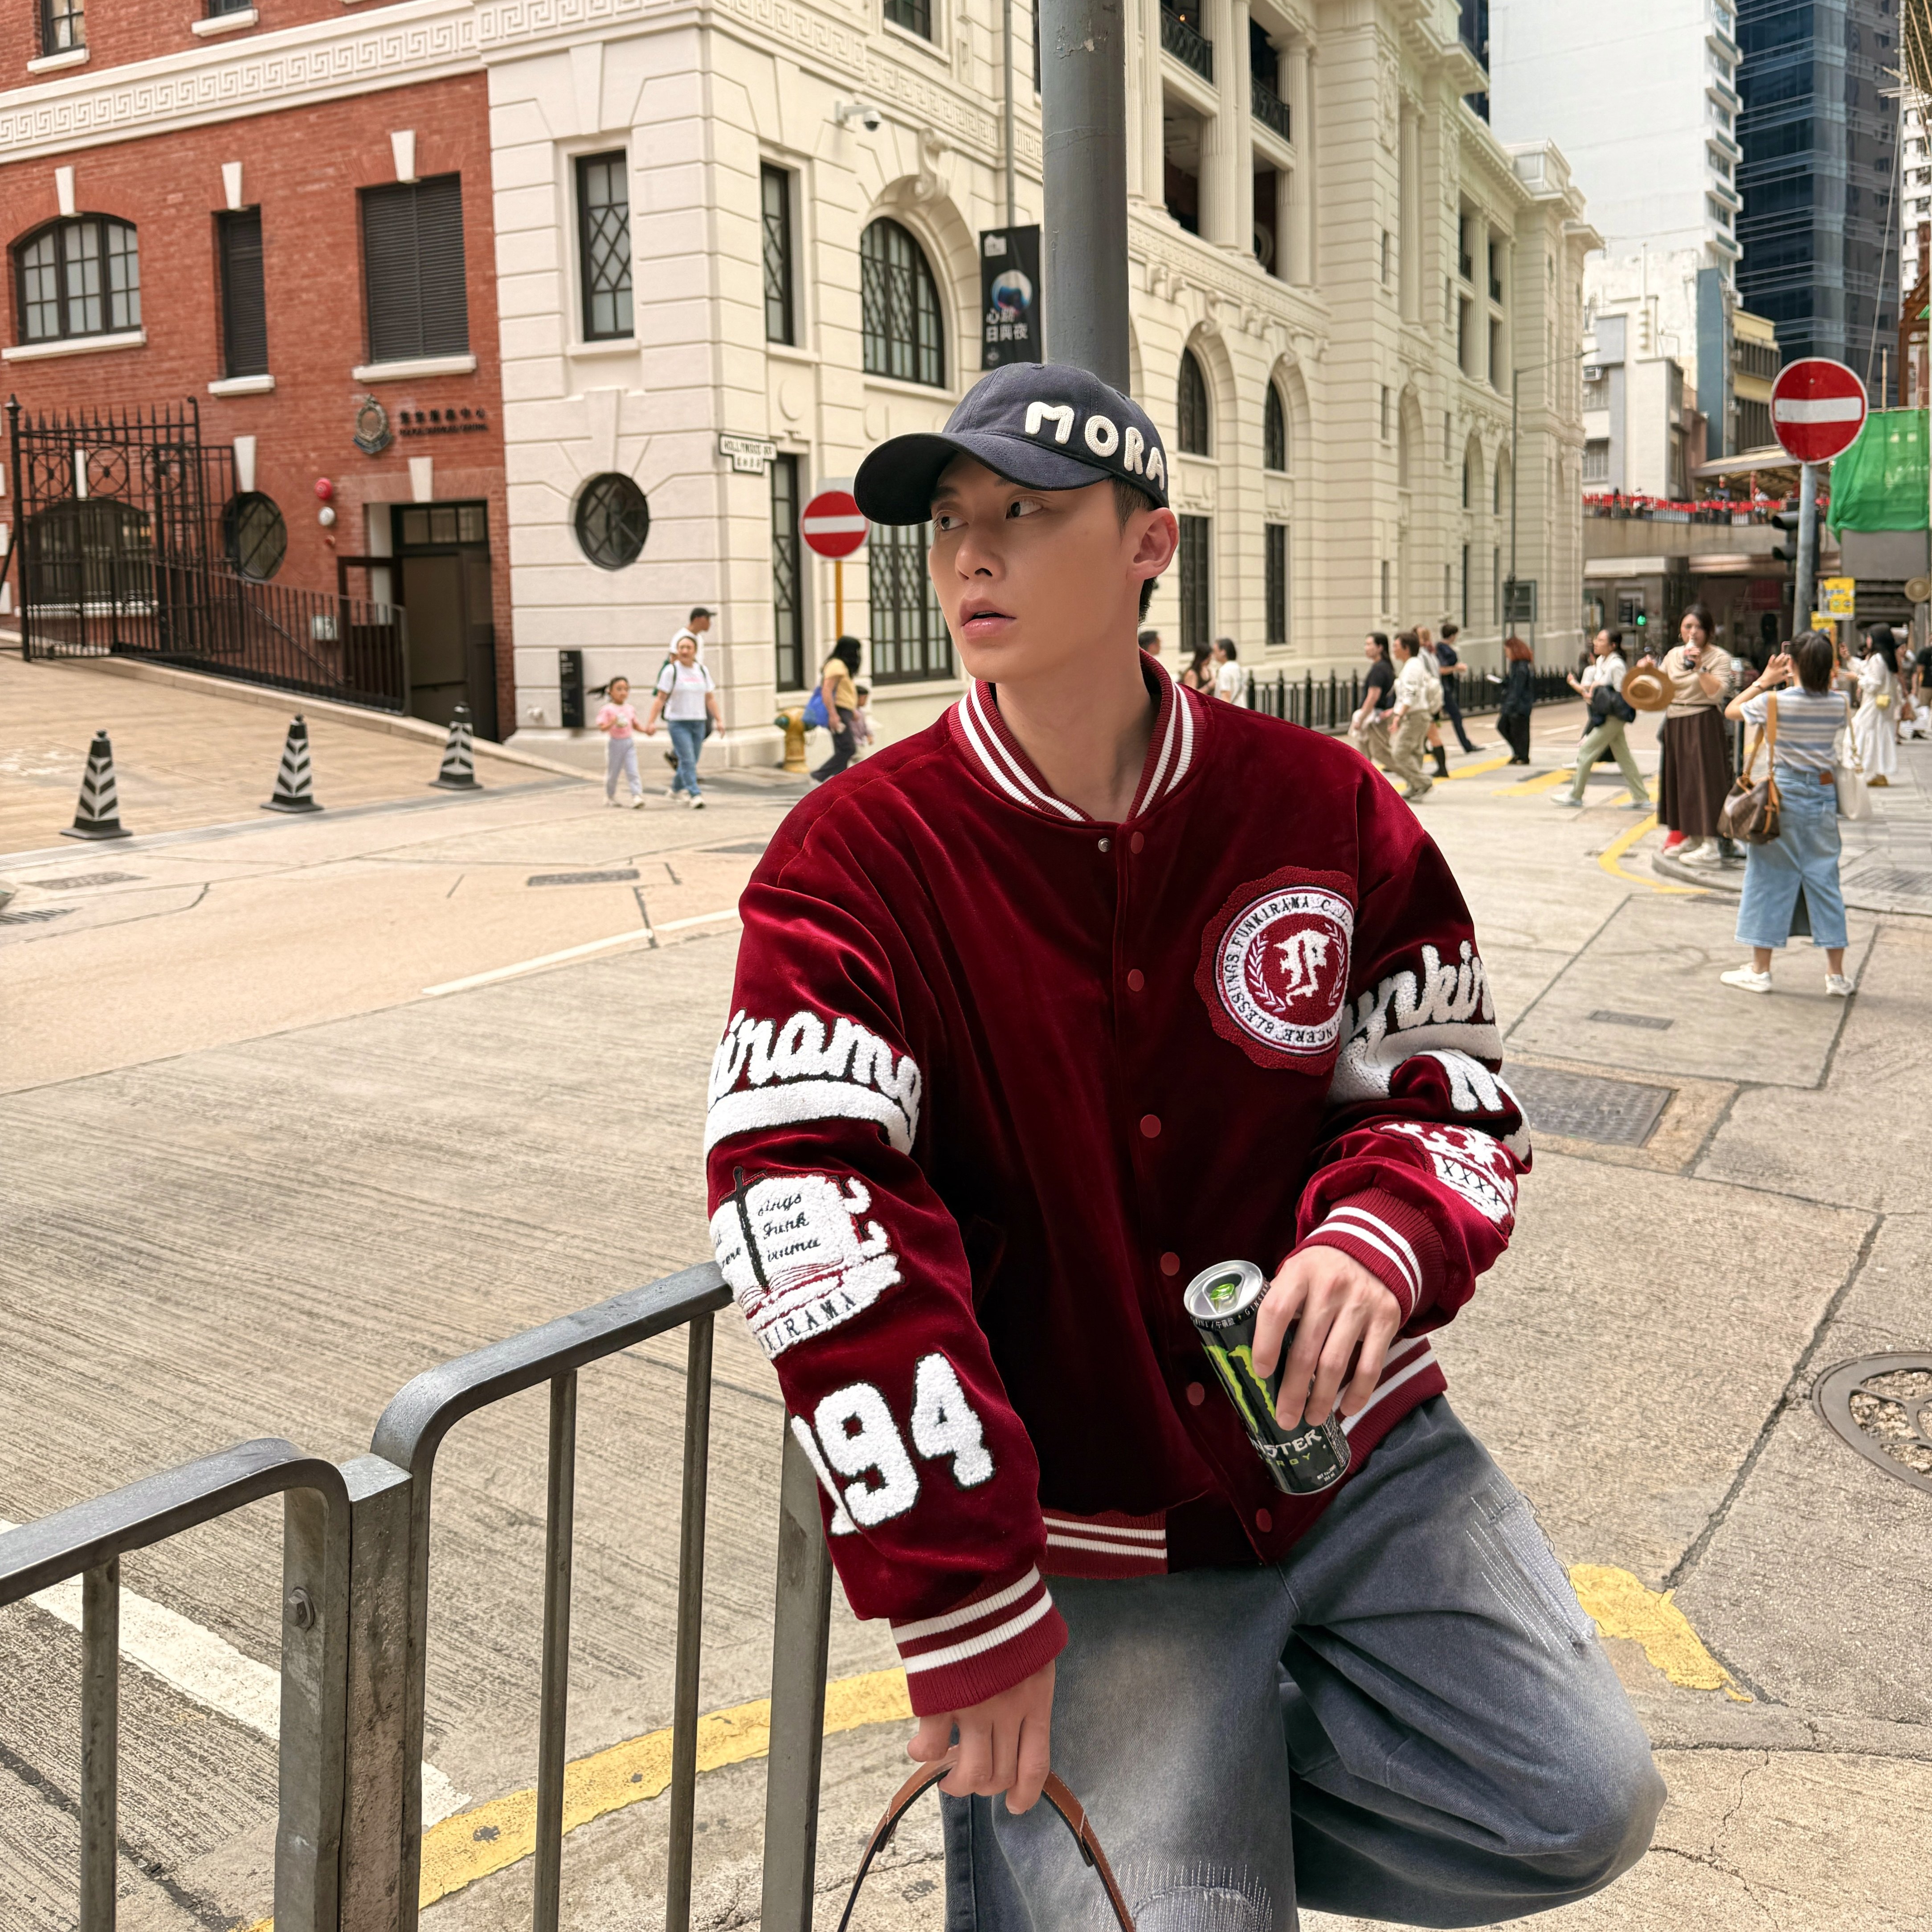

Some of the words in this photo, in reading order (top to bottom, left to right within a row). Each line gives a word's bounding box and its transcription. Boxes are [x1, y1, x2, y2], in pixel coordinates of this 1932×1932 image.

[1025, 401, 1164, 490] MORA
[1232, 895, 1309, 948] FUNKIRAMA
[1225, 954, 1274, 1033] BLESSINGS
[1284, 1018, 1340, 1043] INCERE
